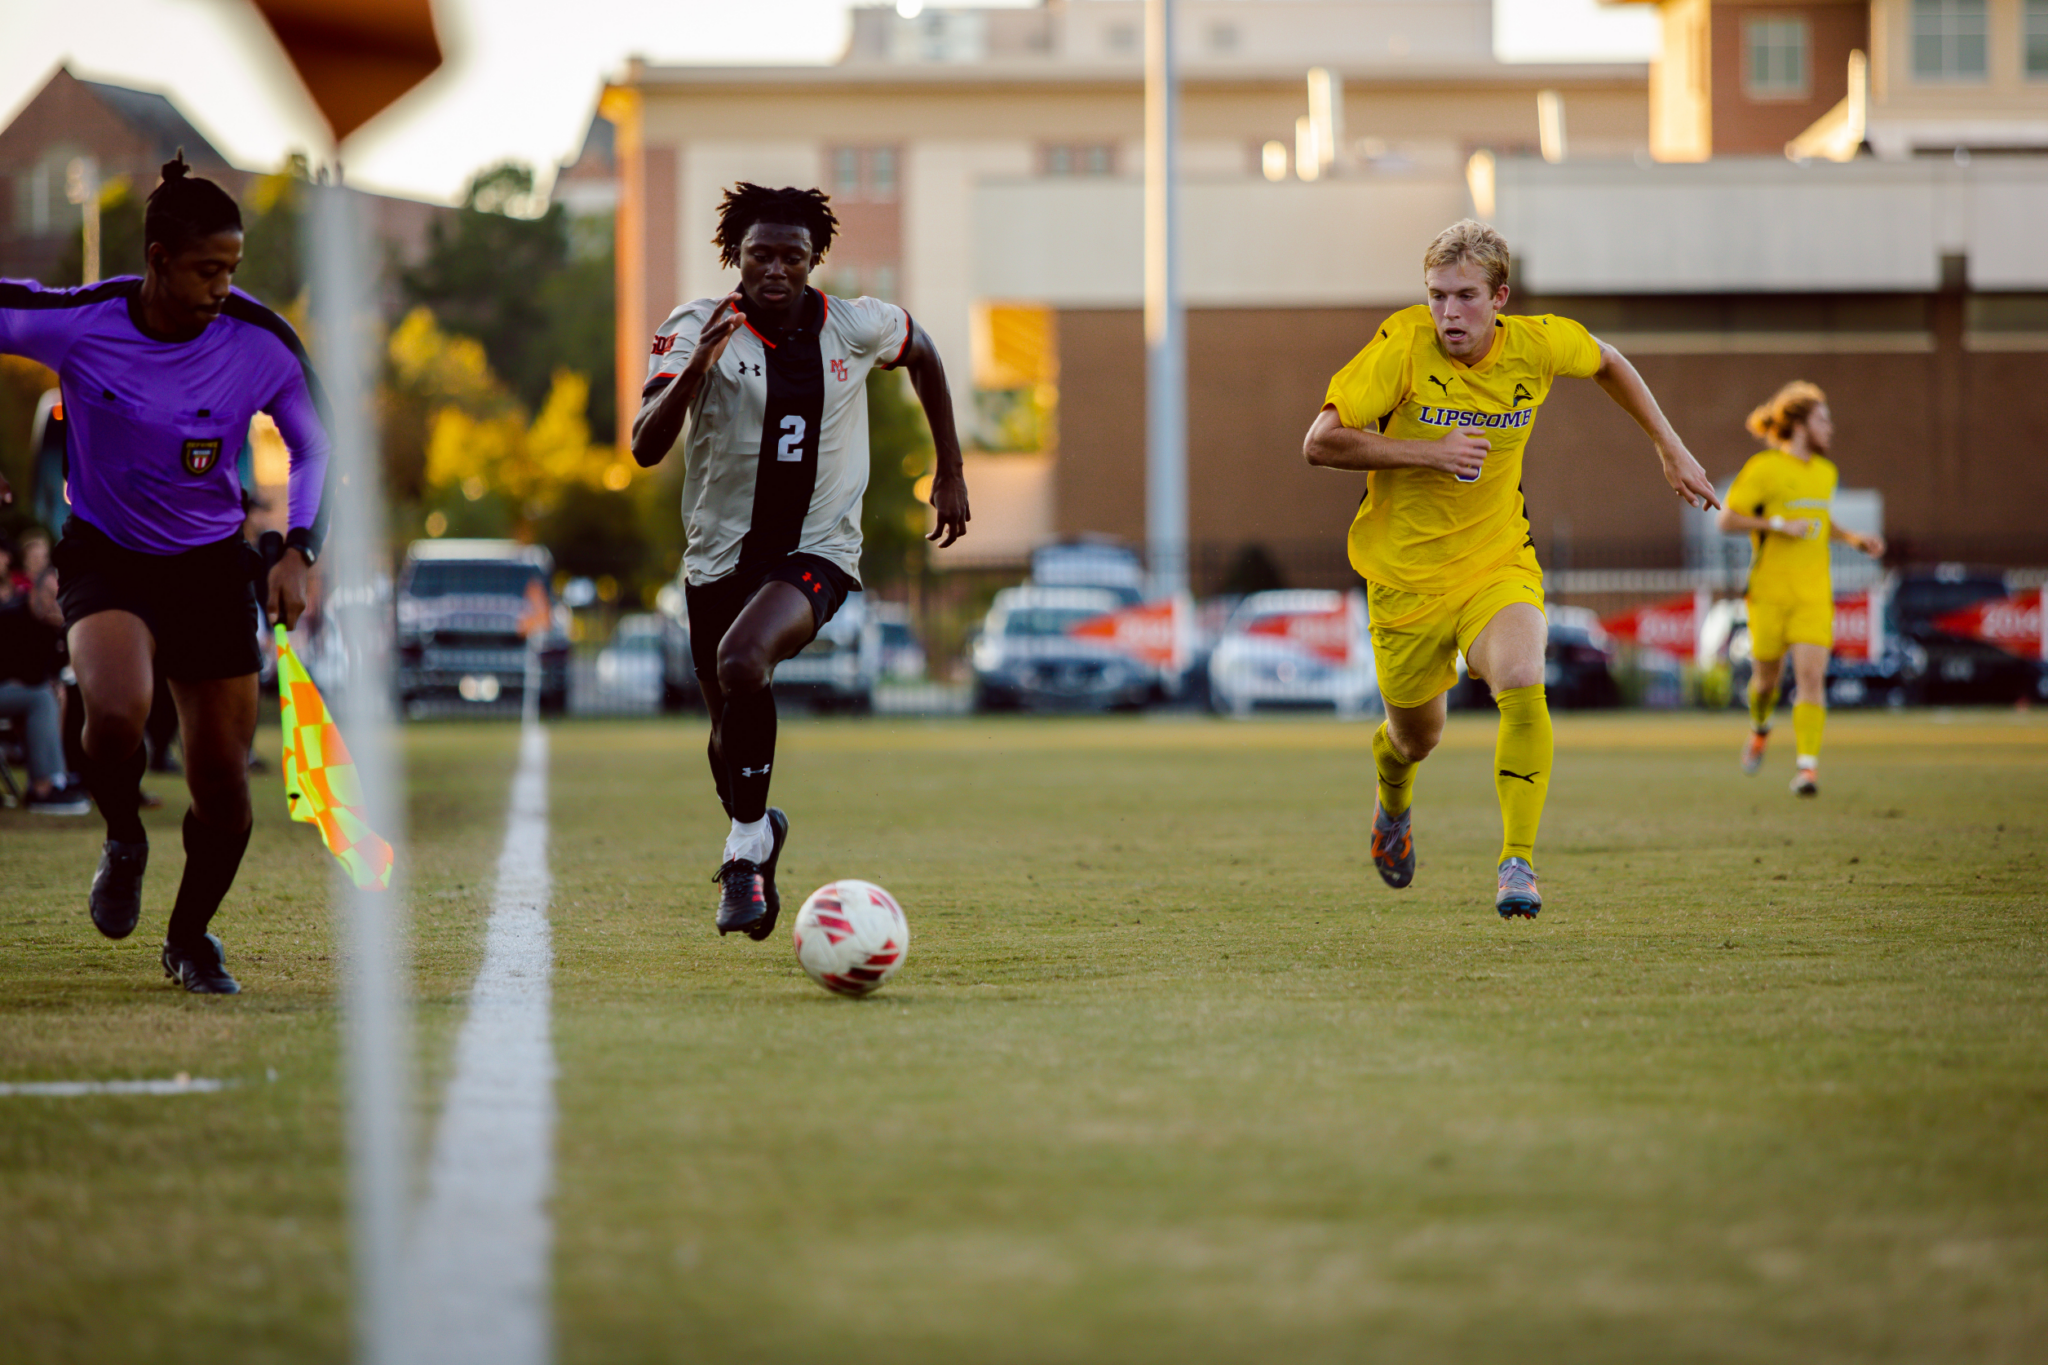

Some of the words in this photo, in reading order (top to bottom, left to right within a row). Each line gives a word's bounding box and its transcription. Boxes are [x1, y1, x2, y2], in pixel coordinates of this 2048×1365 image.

[830, 359, 848, 381] MU
[1418, 406, 1533, 428] LIPSCOMB
[777, 415, 806, 461] 2
